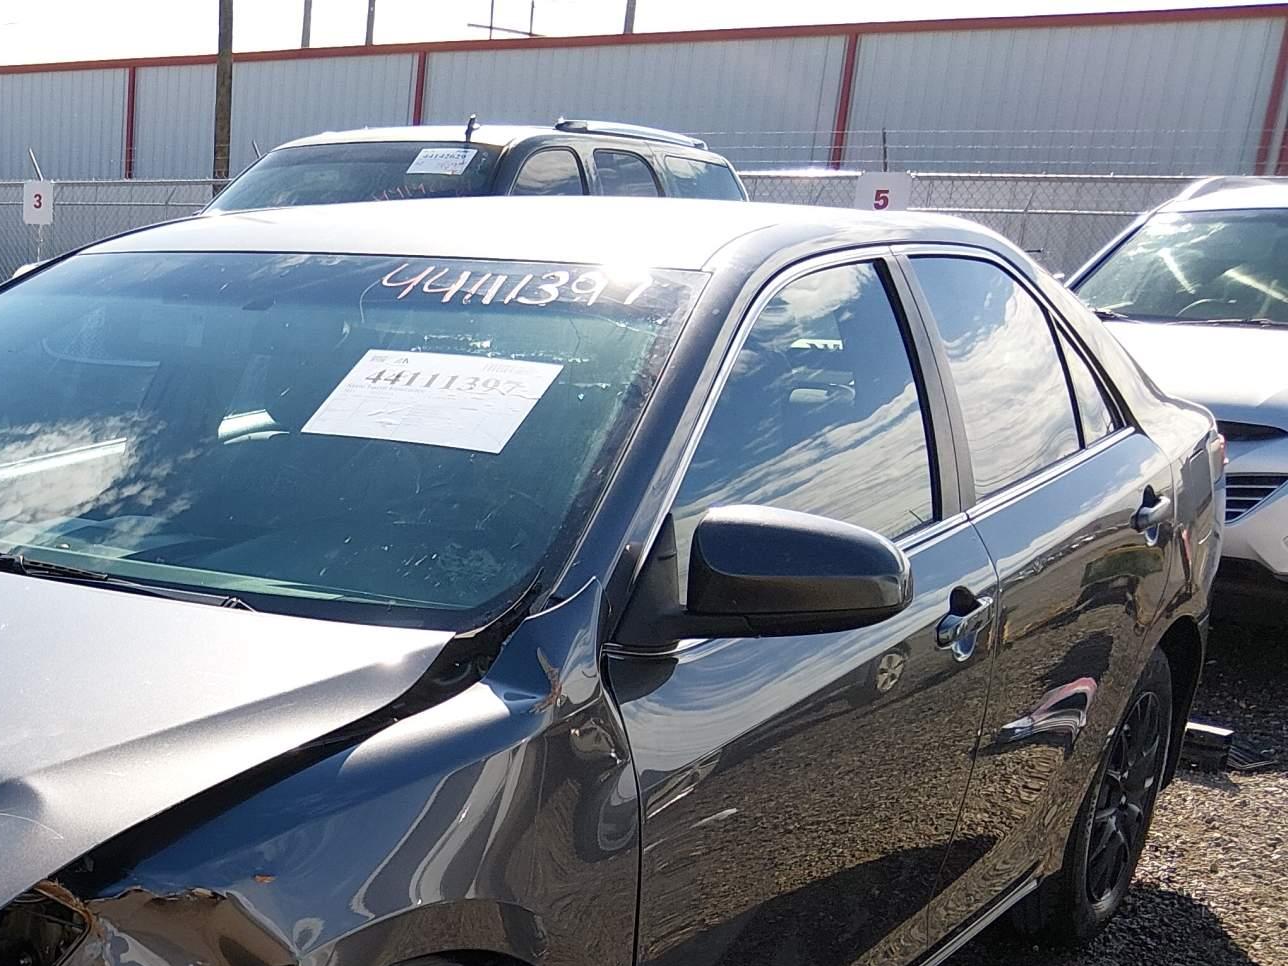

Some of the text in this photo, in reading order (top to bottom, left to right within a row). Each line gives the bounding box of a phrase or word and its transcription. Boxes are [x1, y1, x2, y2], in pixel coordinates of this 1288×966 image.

[33, 193, 42, 209] 3
[873, 189, 890, 210] 5
[365, 368, 526, 396] 44111397
